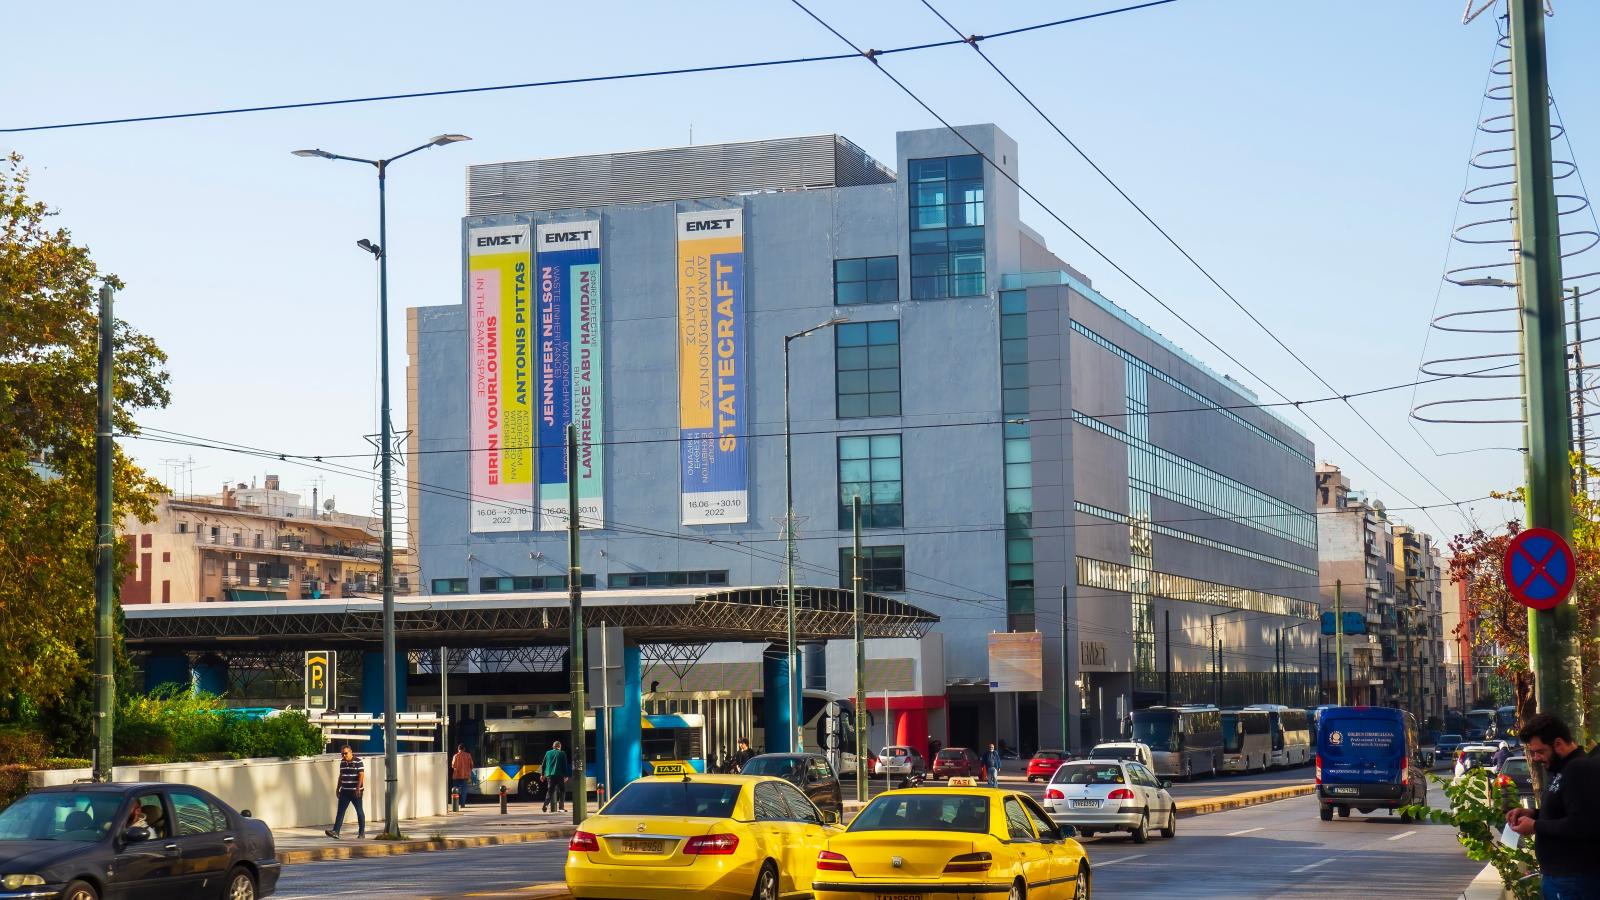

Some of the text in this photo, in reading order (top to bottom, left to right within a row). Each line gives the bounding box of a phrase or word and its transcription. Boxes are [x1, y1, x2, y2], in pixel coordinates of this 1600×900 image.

[477, 234, 523, 248] ΕΜΣΤ
[546, 230, 592, 244] ΕΜΣΤ
[686, 218, 734, 232] ΕΜΣΤ
[477, 278, 484, 290] IN
[685, 256, 696, 346] ΤΟ ΚΡΑΤΟΣ
[515, 262, 526, 405] ANTONIS PITTAS
[542, 266, 554, 426] JENNIFER NELSON
[716, 260, 737, 452] STATECRAFT
[477, 359, 485, 397] SPACE
[487, 316, 498, 486] EIRINI VOURLOUMIS
[580, 270, 592, 479] LAWRENCE ABU HAMDAN
[312, 665, 323, 689] P
